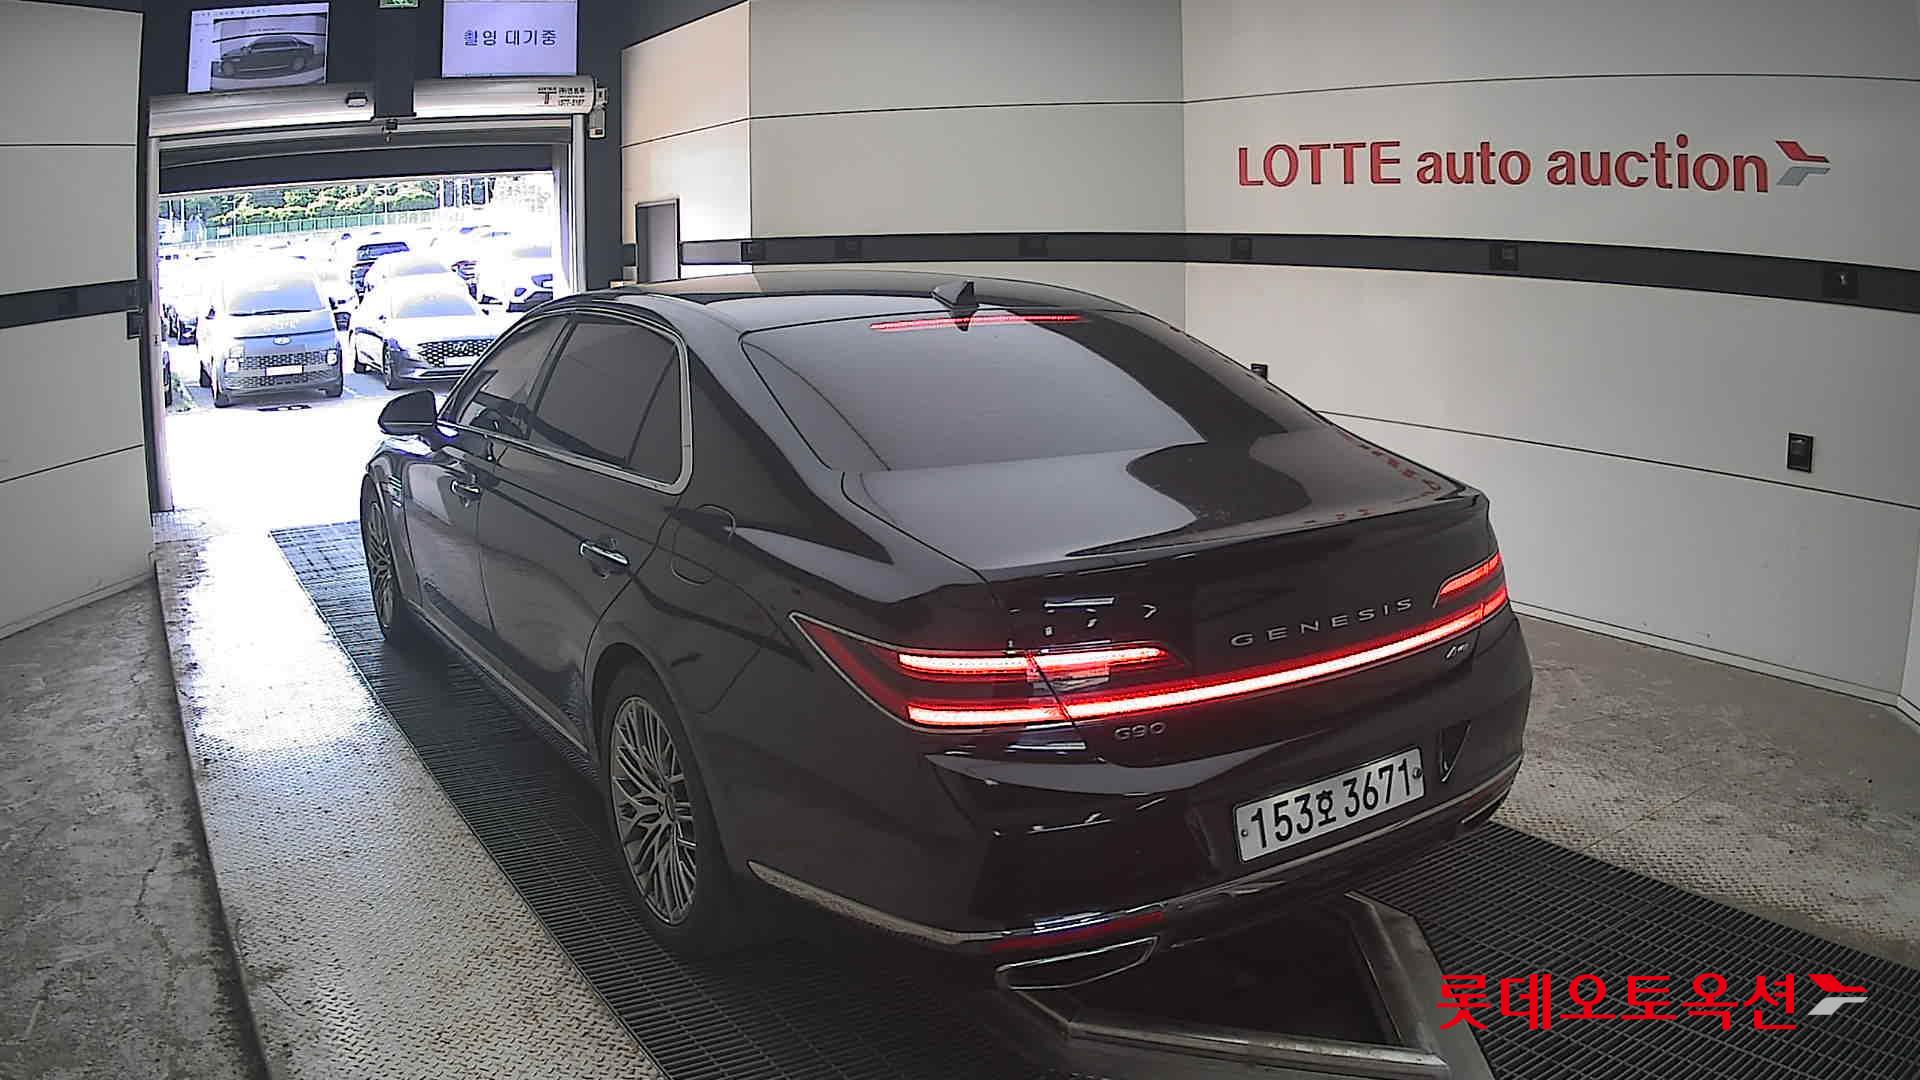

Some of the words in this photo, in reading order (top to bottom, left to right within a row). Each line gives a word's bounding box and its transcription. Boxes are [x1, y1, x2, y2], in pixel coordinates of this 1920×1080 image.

[505, 29, 556, 46] 대기중
[1239, 141, 1401, 187] LOTTE
[1416, 141, 1531, 185] auto
[1546, 133, 1768, 194] auction
[1231, 598, 1414, 646] GENESIS
[1113, 721, 1167, 742] G90
[1343, 758, 1412, 818] 3671
